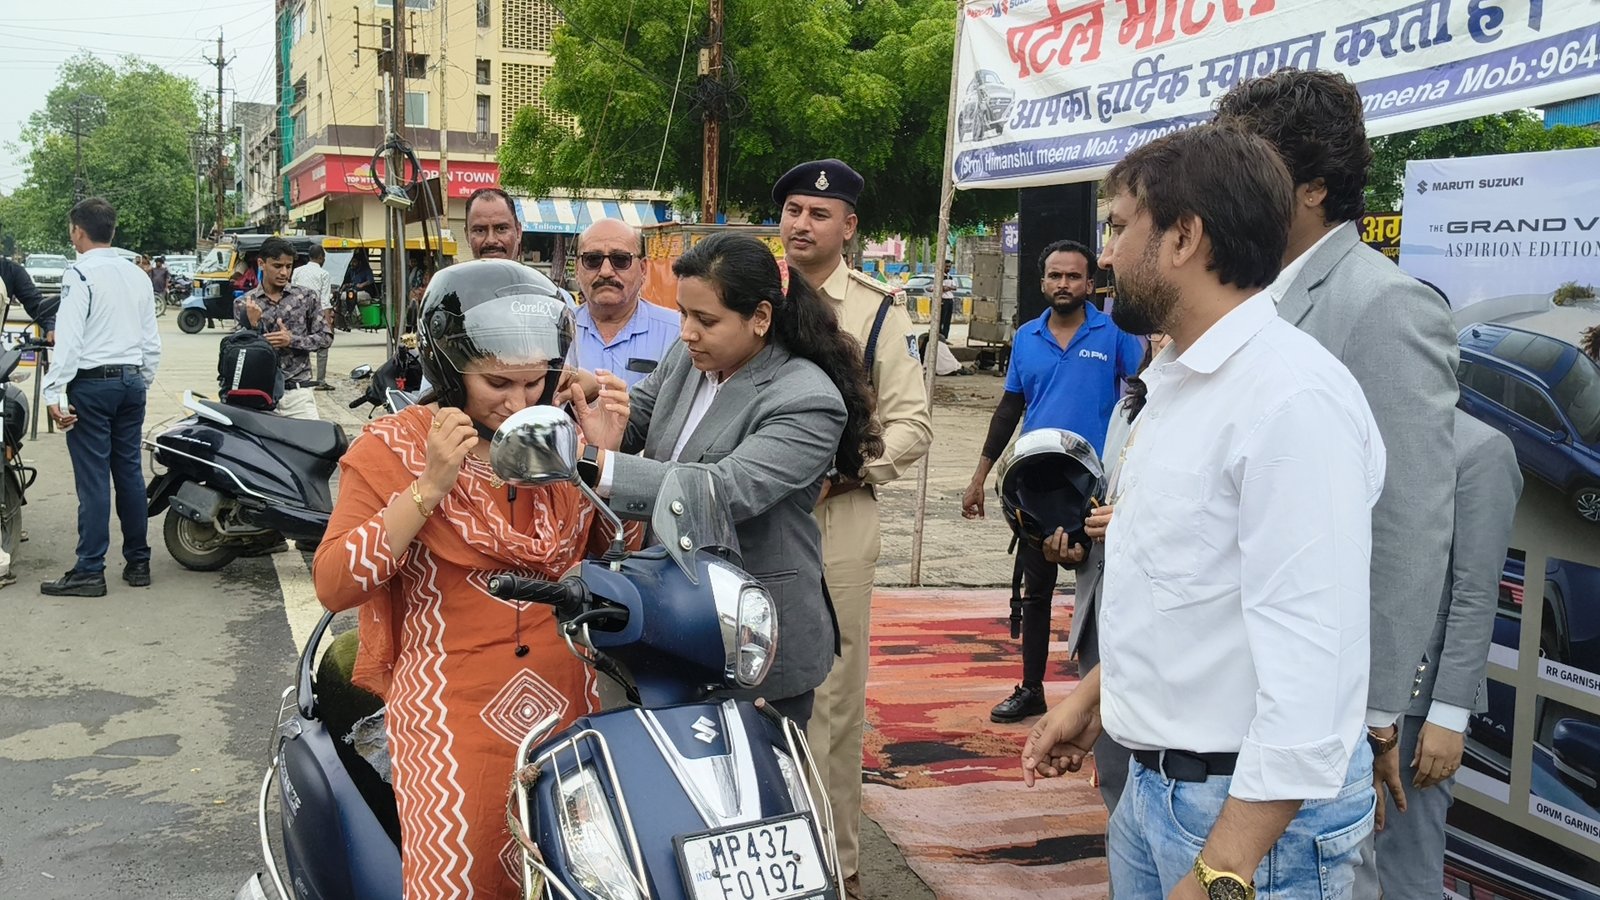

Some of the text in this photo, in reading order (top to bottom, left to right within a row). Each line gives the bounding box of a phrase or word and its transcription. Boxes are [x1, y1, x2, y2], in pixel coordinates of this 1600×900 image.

[1010, 86, 1091, 130] आपका
[1097, 53, 1193, 124] हार्दिक
[1334, 0, 1452, 66] करता
[1362, 79, 1449, 112] meena
[985, 149, 1034, 171] Himanshu
[1037, 143, 1081, 164] meena
[1083, 136, 1120, 158] Mob:
[456, 171, 494, 183] TOWN
[1432, 177, 1524, 191] MARUTI SUZUKI
[1429, 224, 1444, 233] THE
[1446, 217, 1567, 234] GRAND
[1444, 242, 1522, 258] ASPIRION
[1546, 665, 1558, 677] RR
[1536, 803, 1600, 838] ORVM GARNIS
[709, 825, 793, 869] MP43Z
[696, 870, 712, 882] IND
